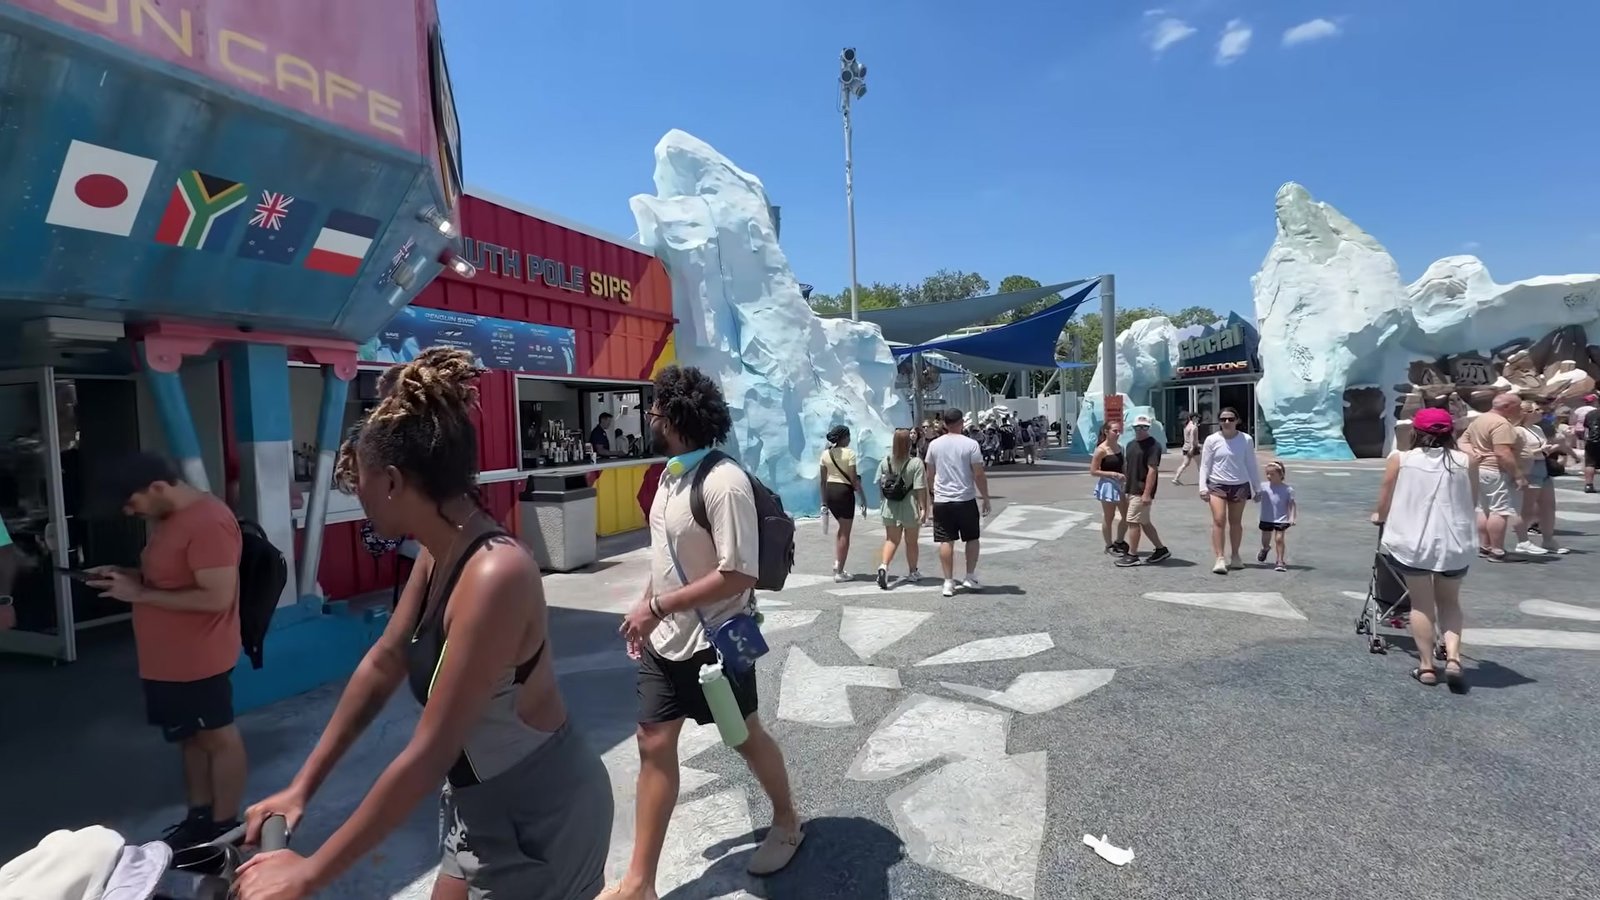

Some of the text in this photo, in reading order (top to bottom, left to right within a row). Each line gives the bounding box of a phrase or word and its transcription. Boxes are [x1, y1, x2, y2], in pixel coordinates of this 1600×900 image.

[218, 29, 405, 137] CAFE
[527, 253, 585, 293] POLE
[590, 271, 632, 303] SIPS
[1177, 360, 1248, 374] COLLECTIONS
